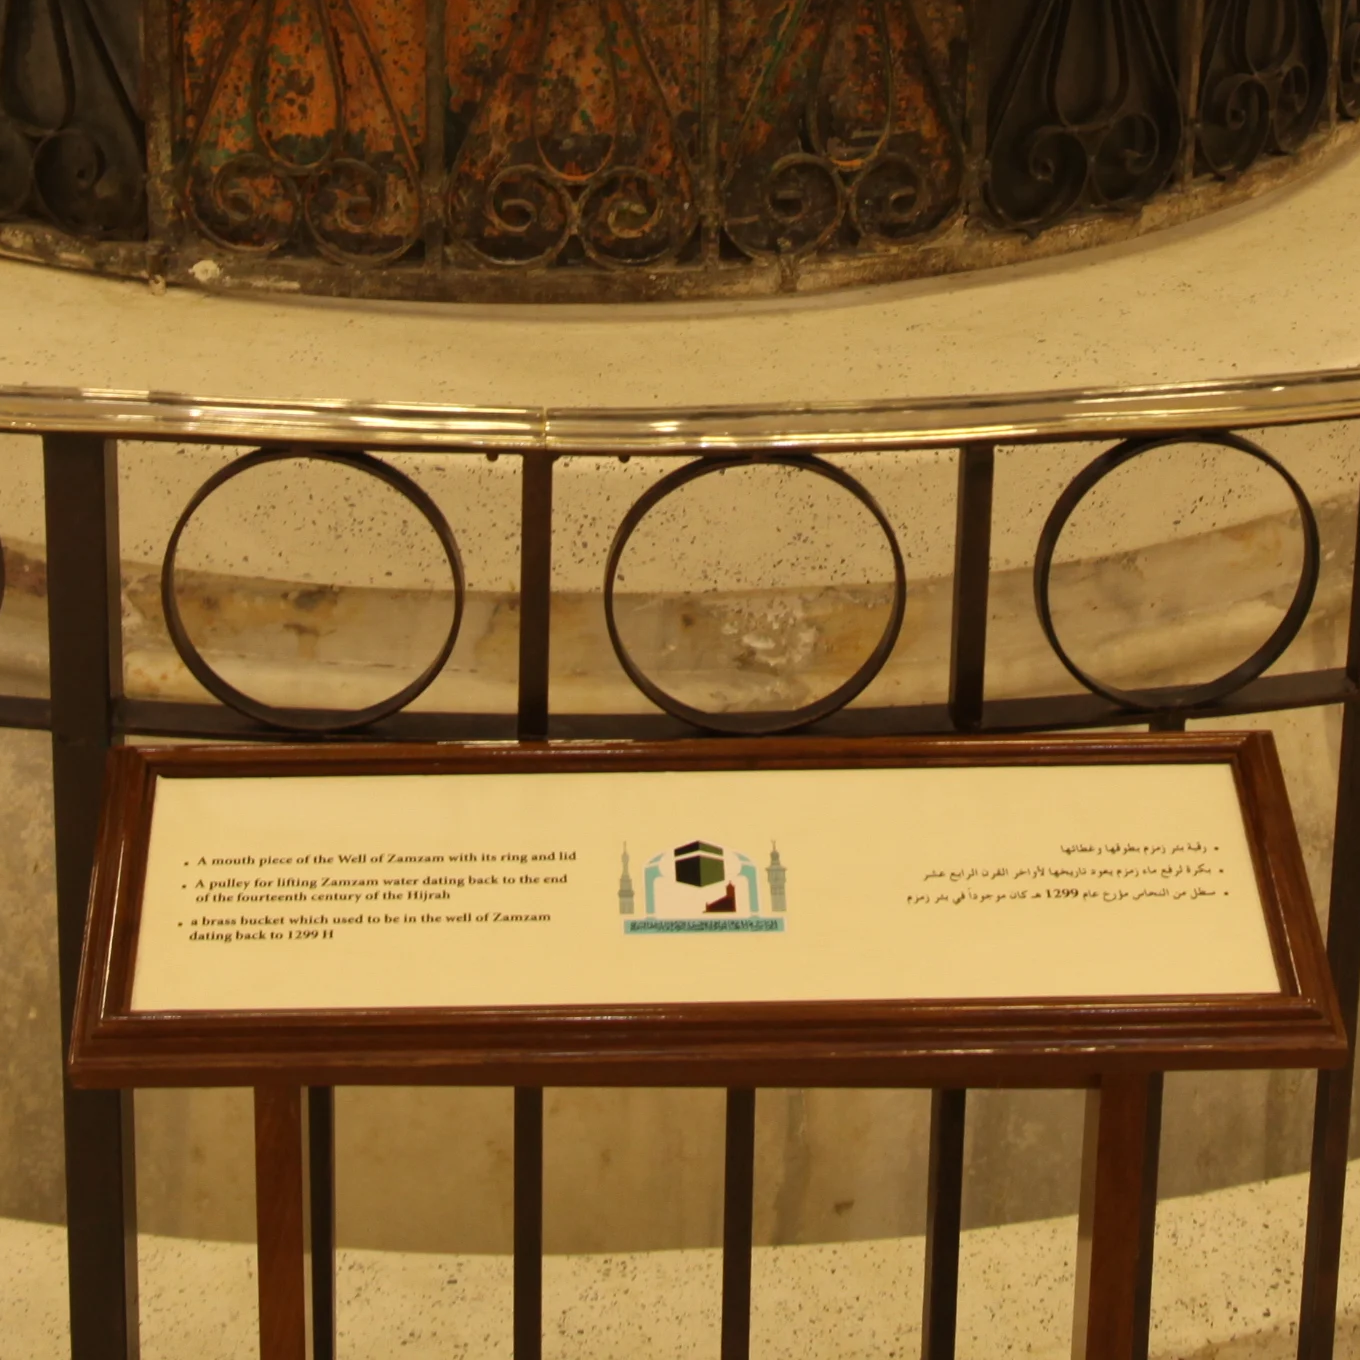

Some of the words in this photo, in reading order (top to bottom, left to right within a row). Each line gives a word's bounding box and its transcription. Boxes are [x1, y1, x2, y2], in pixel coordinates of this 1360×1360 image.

[1060, 843, 1102, 856] وغطائها
[1105, 843, 1140, 855] بطوقها
[1143, 843, 1166, 855] زمزم
[1170, 844, 1184, 855] بئر
[1187, 841, 1207, 854] رقبة
[197, 856, 207, 866] A
[211, 855, 255, 866] mouth
[259, 855, 293, 867] piece
[296, 854, 311, 865] of
[313, 854, 334, 864] the
[338, 853, 367, 864] Well
[370, 853, 384, 863] of
[387, 853, 445, 864] Zamzam
[448, 852, 477, 863] with
[481, 852, 497, 862] its
[501, 852, 528, 864] ring
[531, 851, 556, 861] and
[559, 851, 576, 861] lid
[924, 869, 945, 881] عشر
[949, 867, 978, 882] الرابع
[981, 867, 1009, 880] القرن
[1014, 865, 1045, 880] لأواخر
[1048, 866, 1087, 878] تاريخها
[1091, 867, 1113, 878] يعود
[1116, 866, 1139, 877] زمزم
[1142, 866, 1157, 875] ماء
[1161, 864, 1182, 878] لرفع
[1186, 863, 1211, 876] بكرة
[195, 879, 205, 889] A
[209, 878, 250, 890] pulley
[254, 877, 273, 888] for
[276, 877, 317, 889] lifting
[321, 877, 379, 887] Zamzam
[383, 876, 419, 886] water
[422, 875, 465, 887] dating
[468, 875, 499, 885] back
[502, 876, 516, 884] to
[519, 875, 540, 884] the
[543, 874, 568, 884] end
[196, 893, 210, 903] of
[212, 893, 234, 902] the
[236, 891, 307, 902] fourteenth
[311, 892, 362, 903] century
[365, 891, 379, 901] of
[382, 891, 403, 900] the
[407, 890, 451, 902] Hijrah
[907, 894, 930, 904] زمزم
[934, 893, 949, 904] بئر
[952, 891, 965, 905] في
[1009, 889, 1028, 900] كان
[1046, 888, 1079, 899] 1299
[1082, 889, 1099, 900] عام
[1102, 888, 1129, 902] مؤرخ
[1132, 888, 1169, 900] النحاس
[1173, 890, 1187, 900] من
[1191, 887, 1216, 900] سطل
[202, 916, 237, 926] brass
[240, 915, 284, 925] bucket
[289, 914, 329, 925] which
[333, 914, 363, 924] used
[367, 915, 380, 924] to
[384, 914, 400, 923] be
[404, 914, 417, 923] in
[421, 913, 442, 923] the
[446, 913, 471, 922] well
[475, 912, 489, 922] of
[492, 912, 551, 922] Zamzam
[189, 930, 232, 942] dating
[235, 930, 266, 940] back
[270, 930, 283, 940] to
[288, 930, 319, 939] 1299
[322, 929, 334, 939] H
